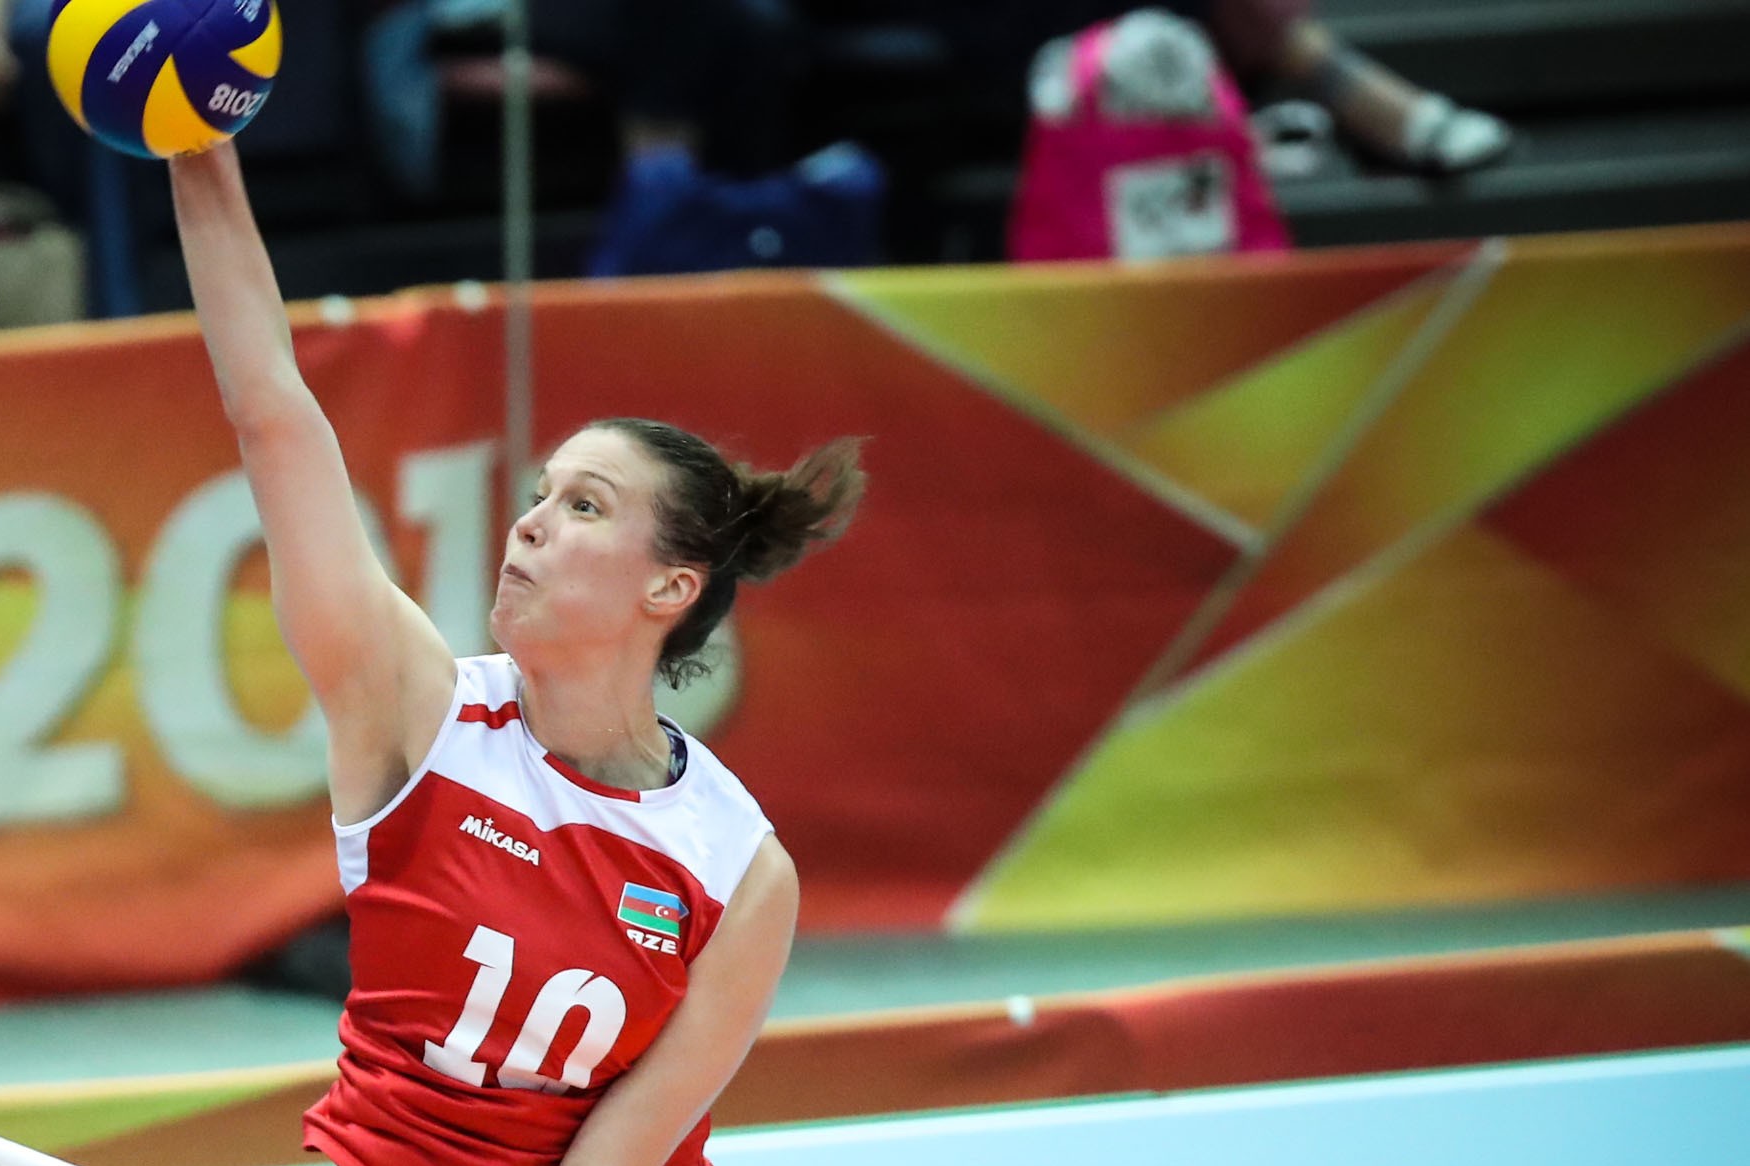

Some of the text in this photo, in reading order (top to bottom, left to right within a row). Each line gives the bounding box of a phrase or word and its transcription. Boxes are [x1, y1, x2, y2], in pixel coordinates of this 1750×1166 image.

[207, 82, 262, 118] 2018
[459, 814, 541, 866] MIKASA
[626, 928, 678, 956] AZE
[422, 924, 627, 1096] 10
